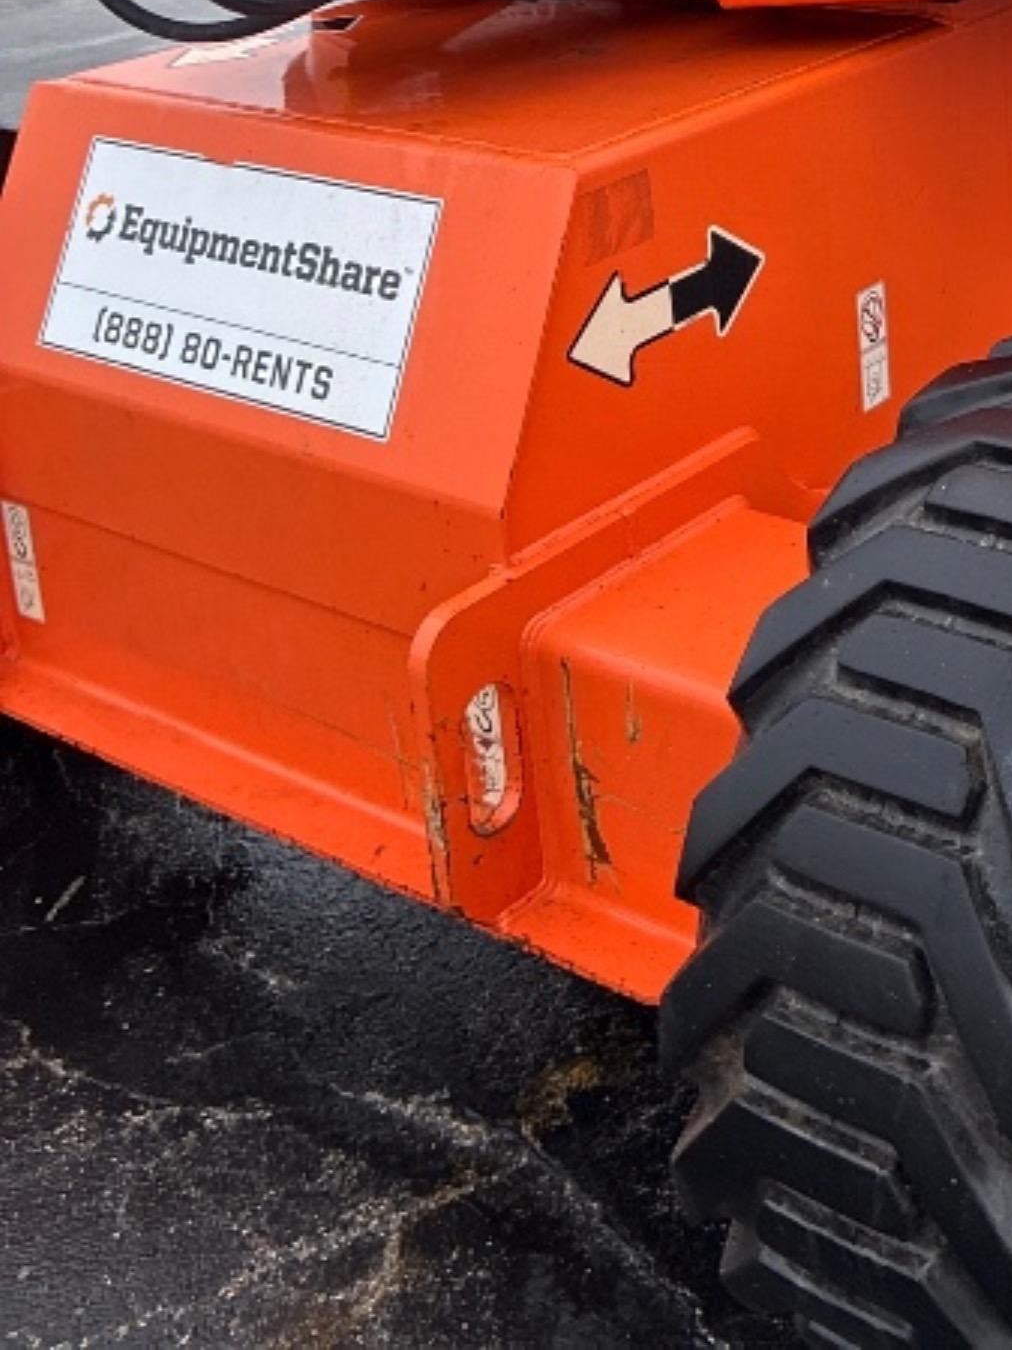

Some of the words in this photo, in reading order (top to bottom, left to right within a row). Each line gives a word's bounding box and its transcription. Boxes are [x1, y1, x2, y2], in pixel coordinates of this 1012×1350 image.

[119, 203, 402, 301] EquipmentShare
[92, 306, 175, 363] (888)
[179, 332, 335, 401] 80-RENTS
